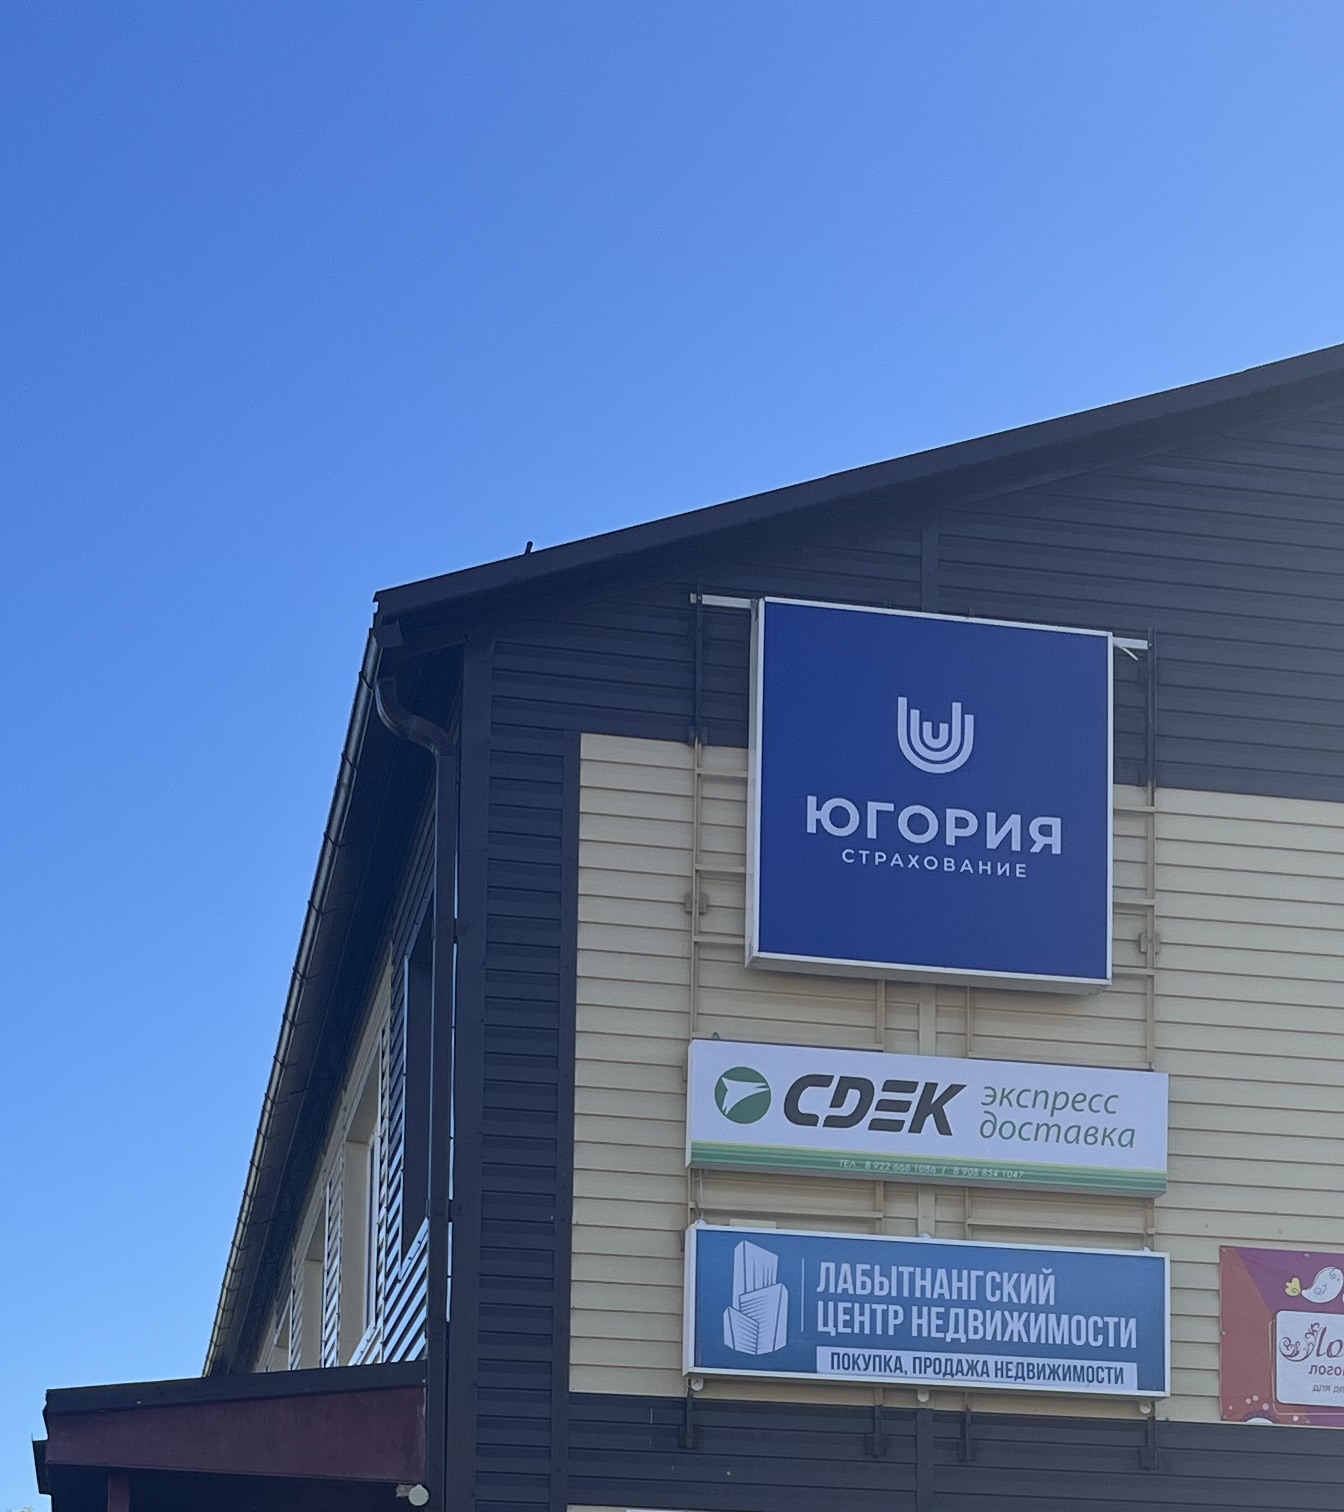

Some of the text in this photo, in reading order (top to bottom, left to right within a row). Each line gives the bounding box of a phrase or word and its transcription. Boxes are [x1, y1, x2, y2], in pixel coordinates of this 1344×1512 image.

[807, 796, 1061, 855] ЮГОРИЯ
[842, 848, 1026, 878] СТРАХОВАНИЕ
[784, 1074, 967, 1136] CDEK
[984, 1085, 1119, 1115] экспресс
[980, 1110, 1135, 1148] доставка
[865, 1161, 870, 1170] 8
[874, 1161, 890, 1171] 922
[953, 1167, 959, 1176] 8
[1003, 1170, 1024, 1179] 1047
[817, 1261, 1055, 1306] ЛАБЫТНАНГСКИЙ
[817, 1300, 1137, 1349] ЦЕНТР НЕДВИЖИМОСТИ
[830, 1352, 1124, 1385] ПОКУПКА, ПРОДАЖА НЕДВИЖИМОСТИ
[1313, 1384, 1330, 1393] для
